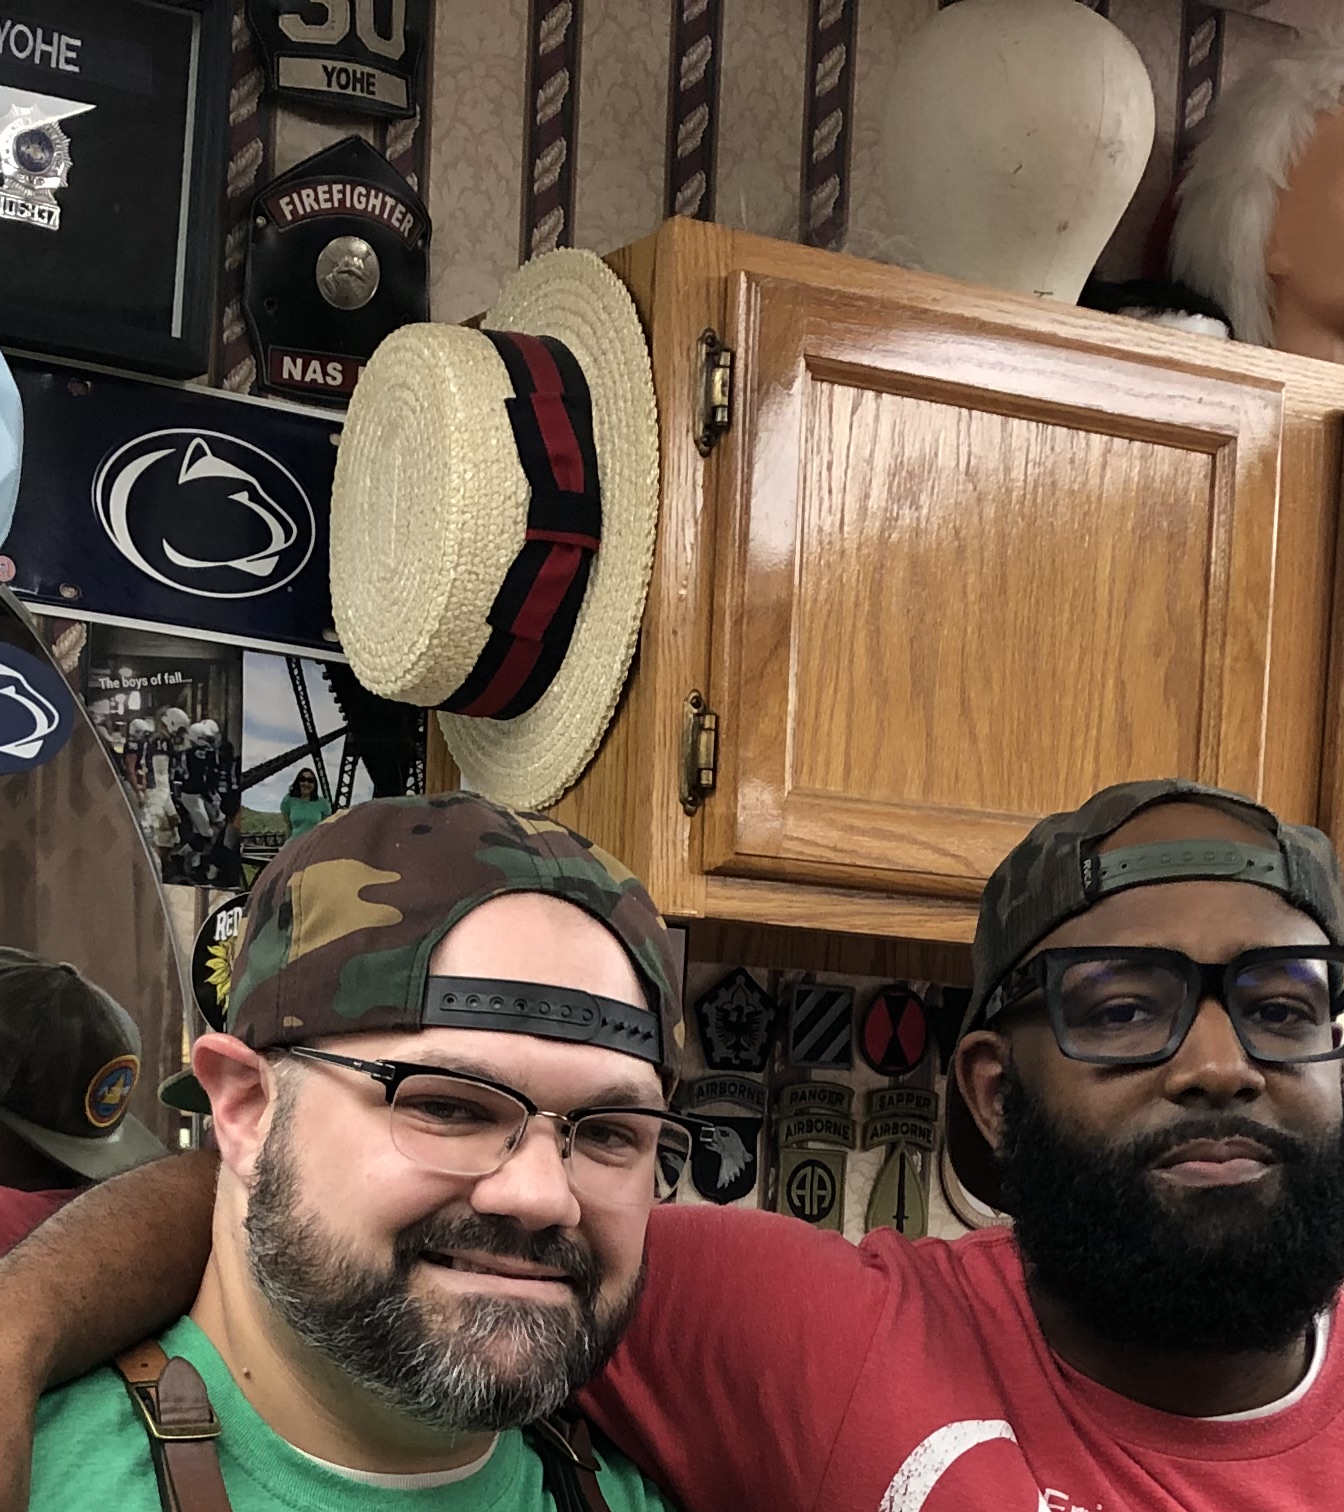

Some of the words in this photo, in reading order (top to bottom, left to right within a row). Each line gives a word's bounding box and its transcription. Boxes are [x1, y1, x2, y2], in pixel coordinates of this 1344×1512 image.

[322, 64, 377, 97] YOHE
[279, 184, 416, 238] FIREFIGHTER
[281, 356, 343, 386] NAS
[98, 677, 120, 690] The
[121, 676, 149, 690] boys
[150, 673, 162, 685] of
[696, 1081, 766, 1101] AIRBORNE
[790, 1088, 845, 1105] RANGER
[878, 1093, 933, 1110] SAPPER
[785, 1123, 850, 1141] AIRBORNE
[869, 1126, 933, 1143] AIRBORNE
